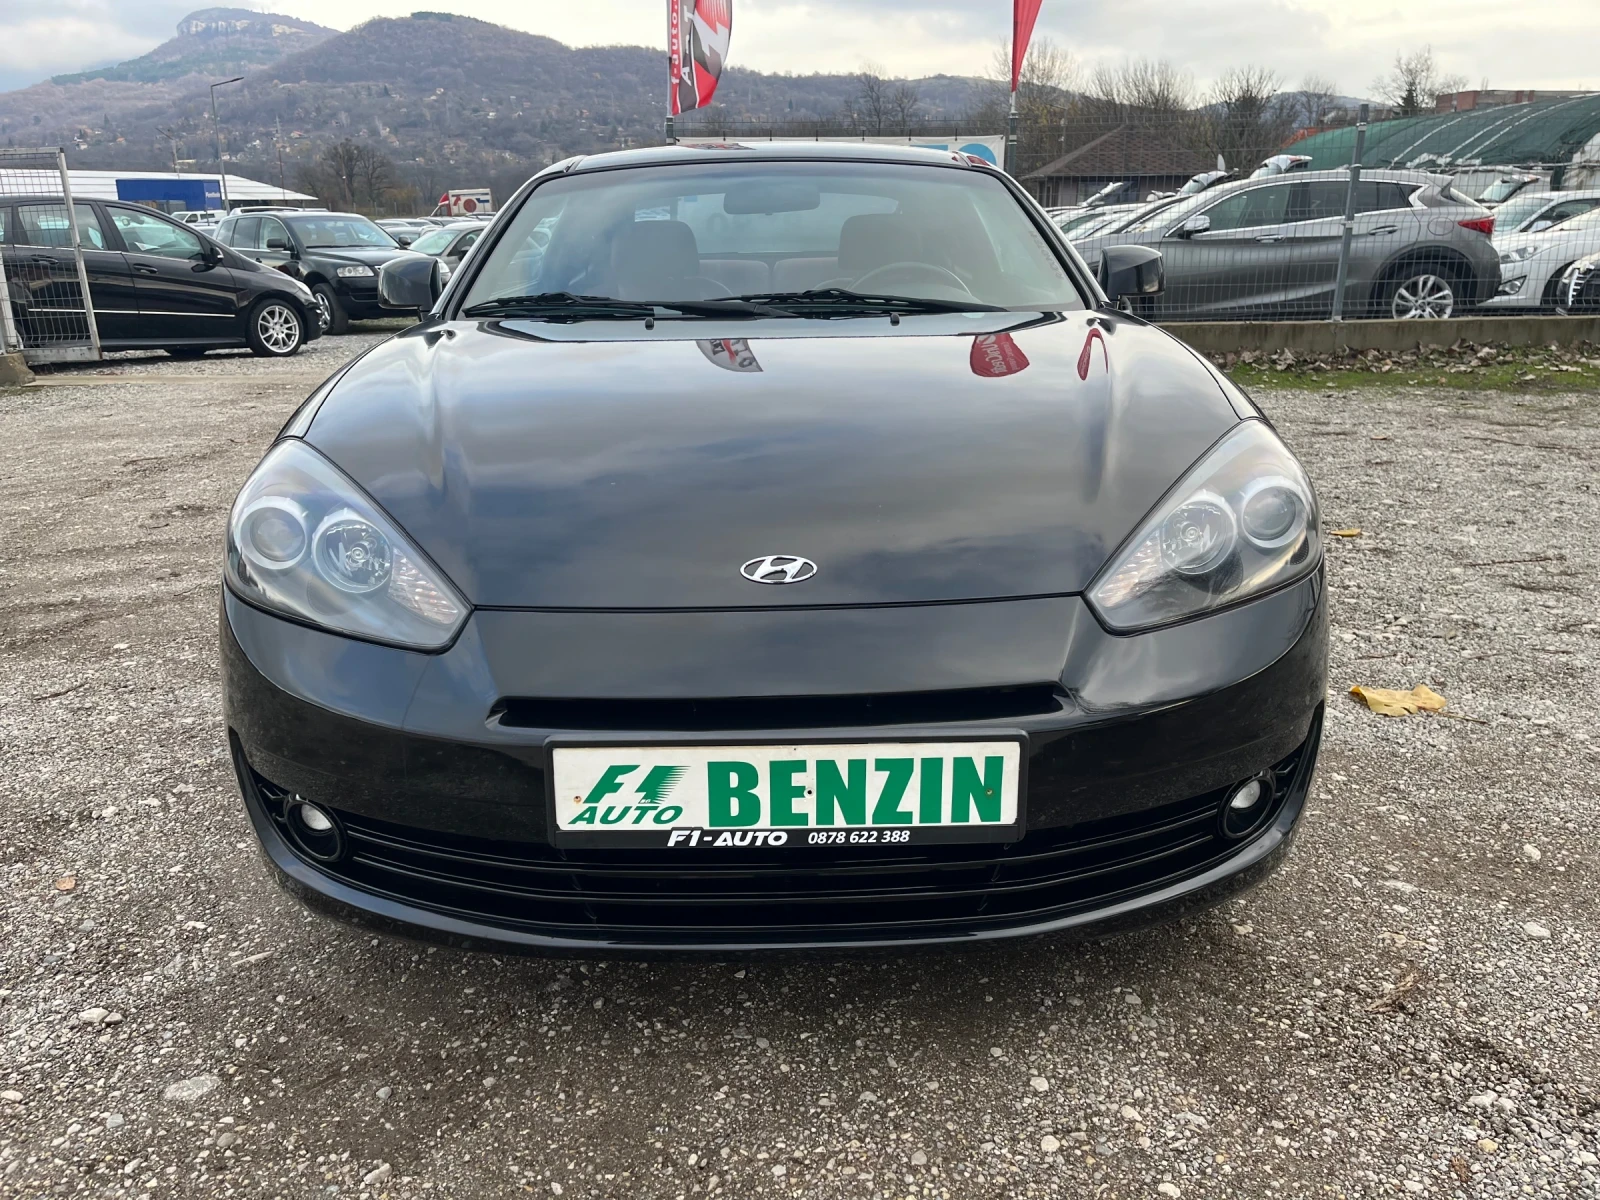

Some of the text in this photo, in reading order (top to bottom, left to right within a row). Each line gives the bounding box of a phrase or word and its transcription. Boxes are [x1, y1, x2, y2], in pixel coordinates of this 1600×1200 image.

[582, 765, 692, 804] F1
[707, 756, 1004, 828] BENZIN
[567, 805, 684, 825] AUTO
[667, 830, 788, 847] F1-AUTO
[807, 830, 911, 845] 0878 622 388
